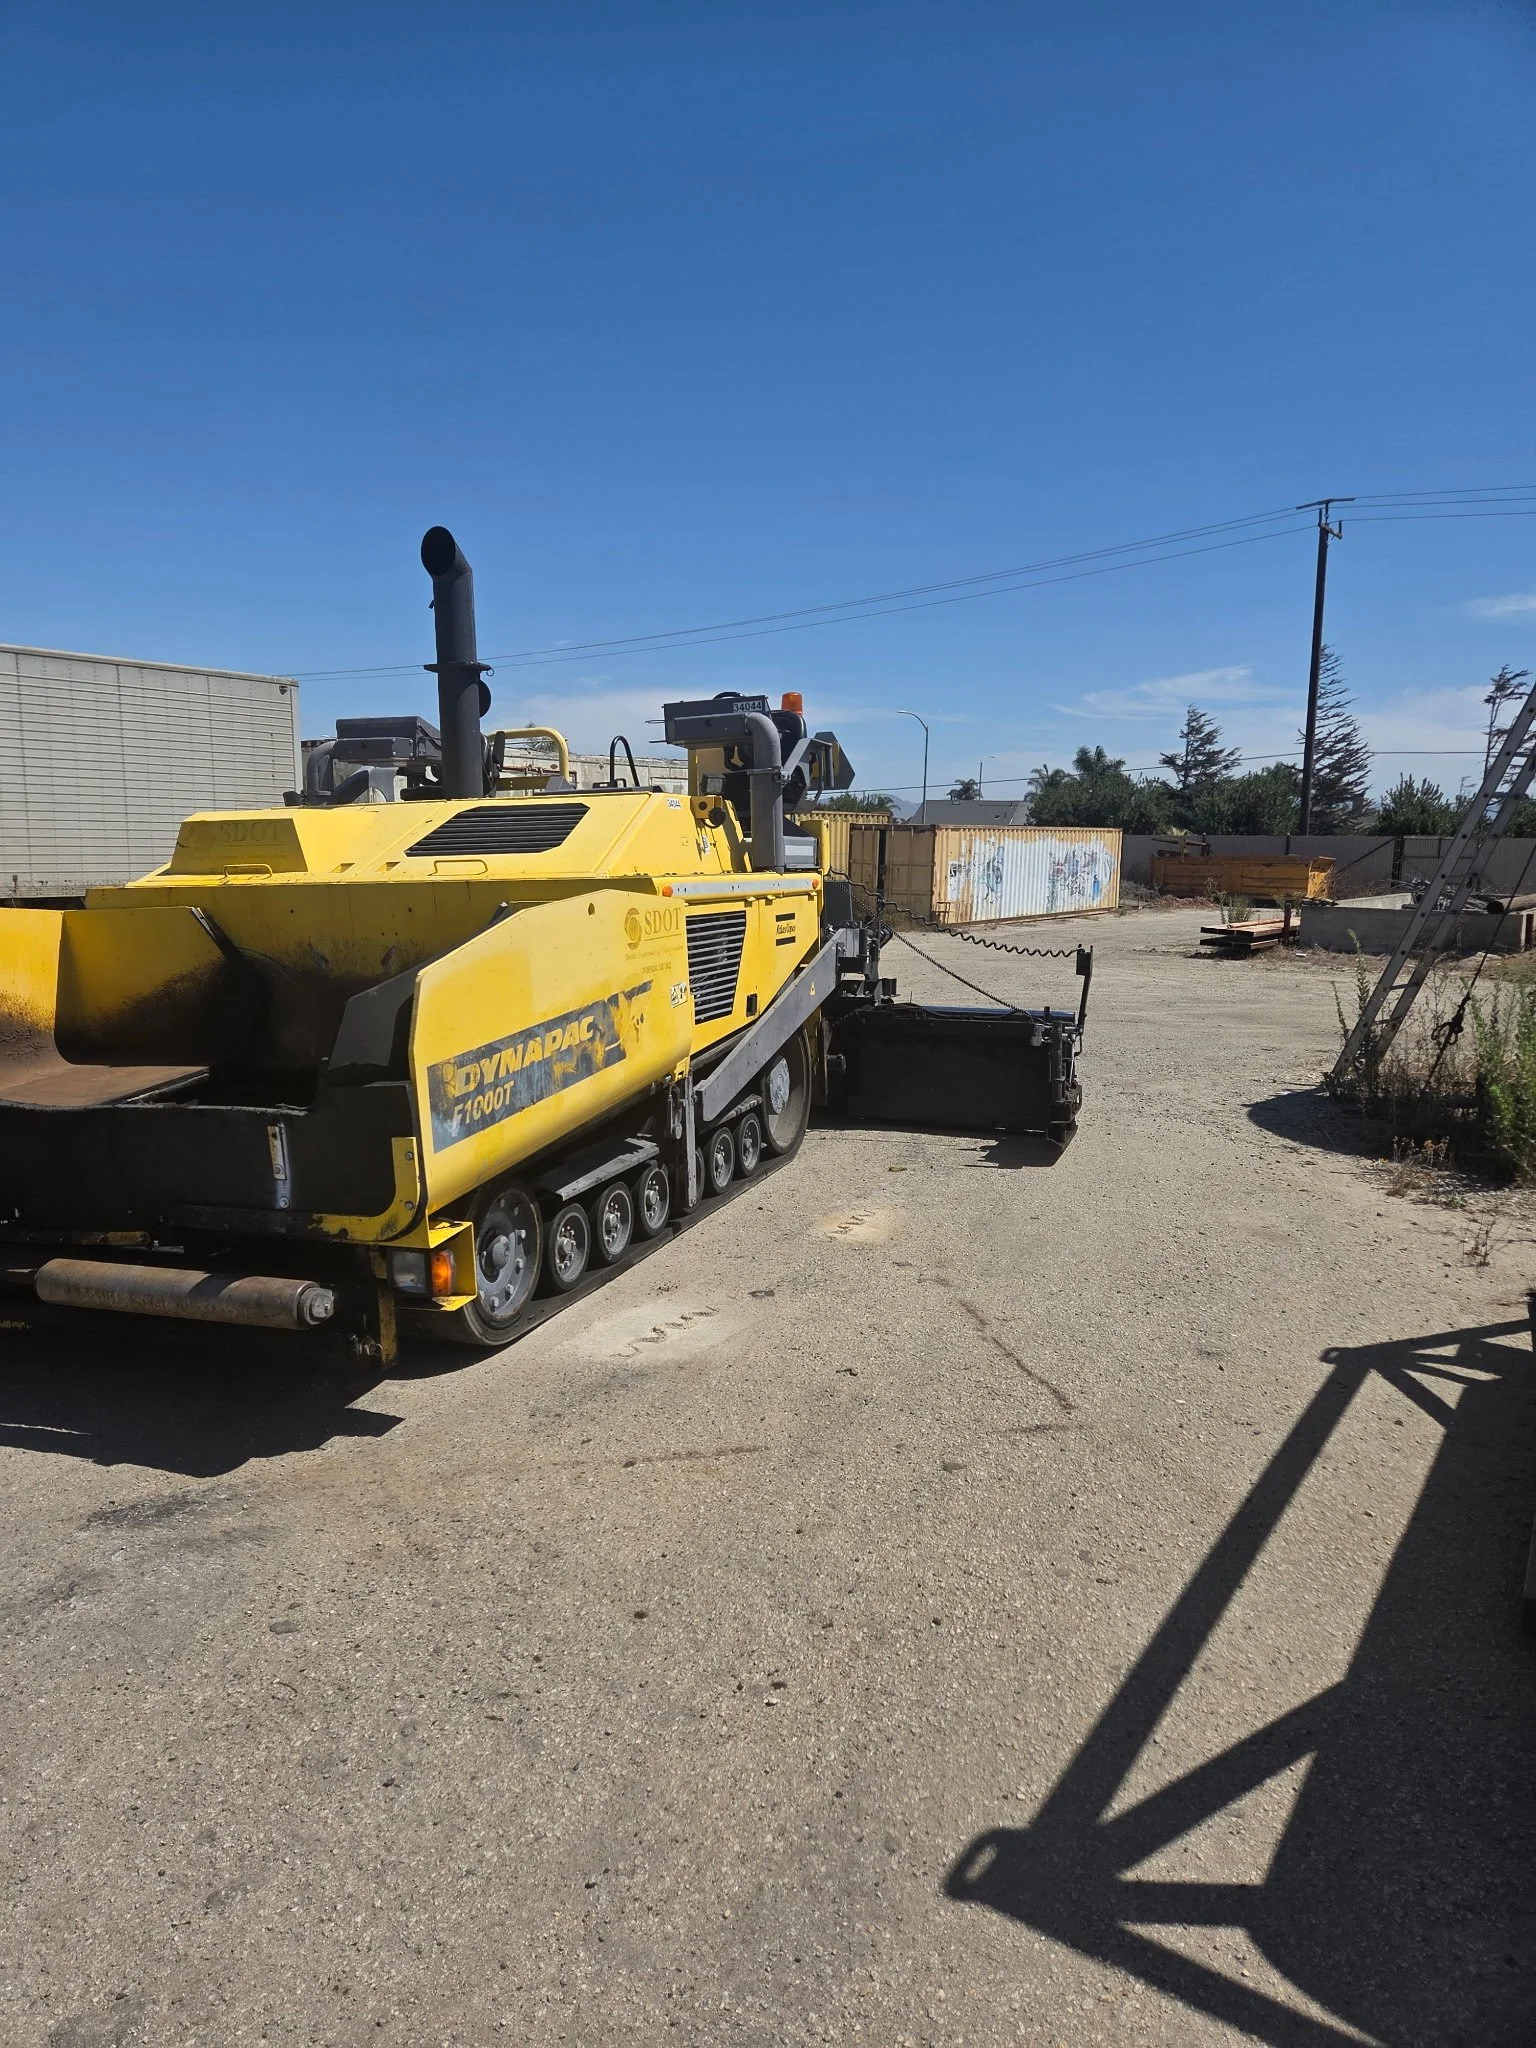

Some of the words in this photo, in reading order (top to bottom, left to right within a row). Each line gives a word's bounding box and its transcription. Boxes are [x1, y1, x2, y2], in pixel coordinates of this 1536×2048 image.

[734, 701, 761, 712] 34044
[220, 821, 282, 842] SDOT
[645, 907, 681, 935] SDOT
[455, 1016, 595, 1097] DYNAPAC
[452, 1080, 515, 1131] F1000T
